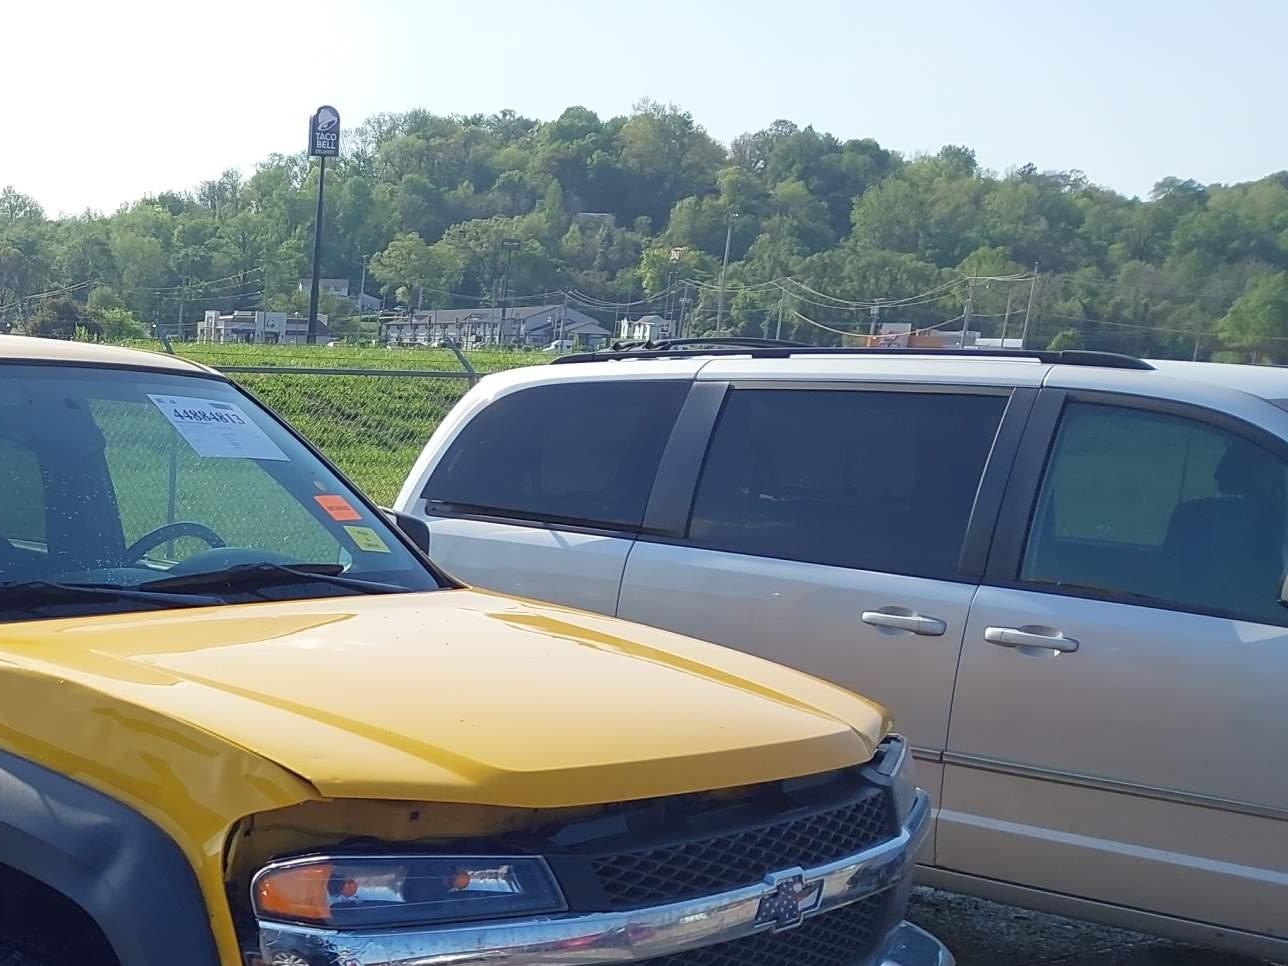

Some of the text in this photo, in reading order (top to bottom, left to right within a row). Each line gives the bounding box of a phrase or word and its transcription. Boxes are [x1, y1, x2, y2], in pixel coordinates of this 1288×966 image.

[315, 132, 337, 141] TACO
[316, 140, 336, 150] BELL
[173, 408, 246, 425] 44884813
